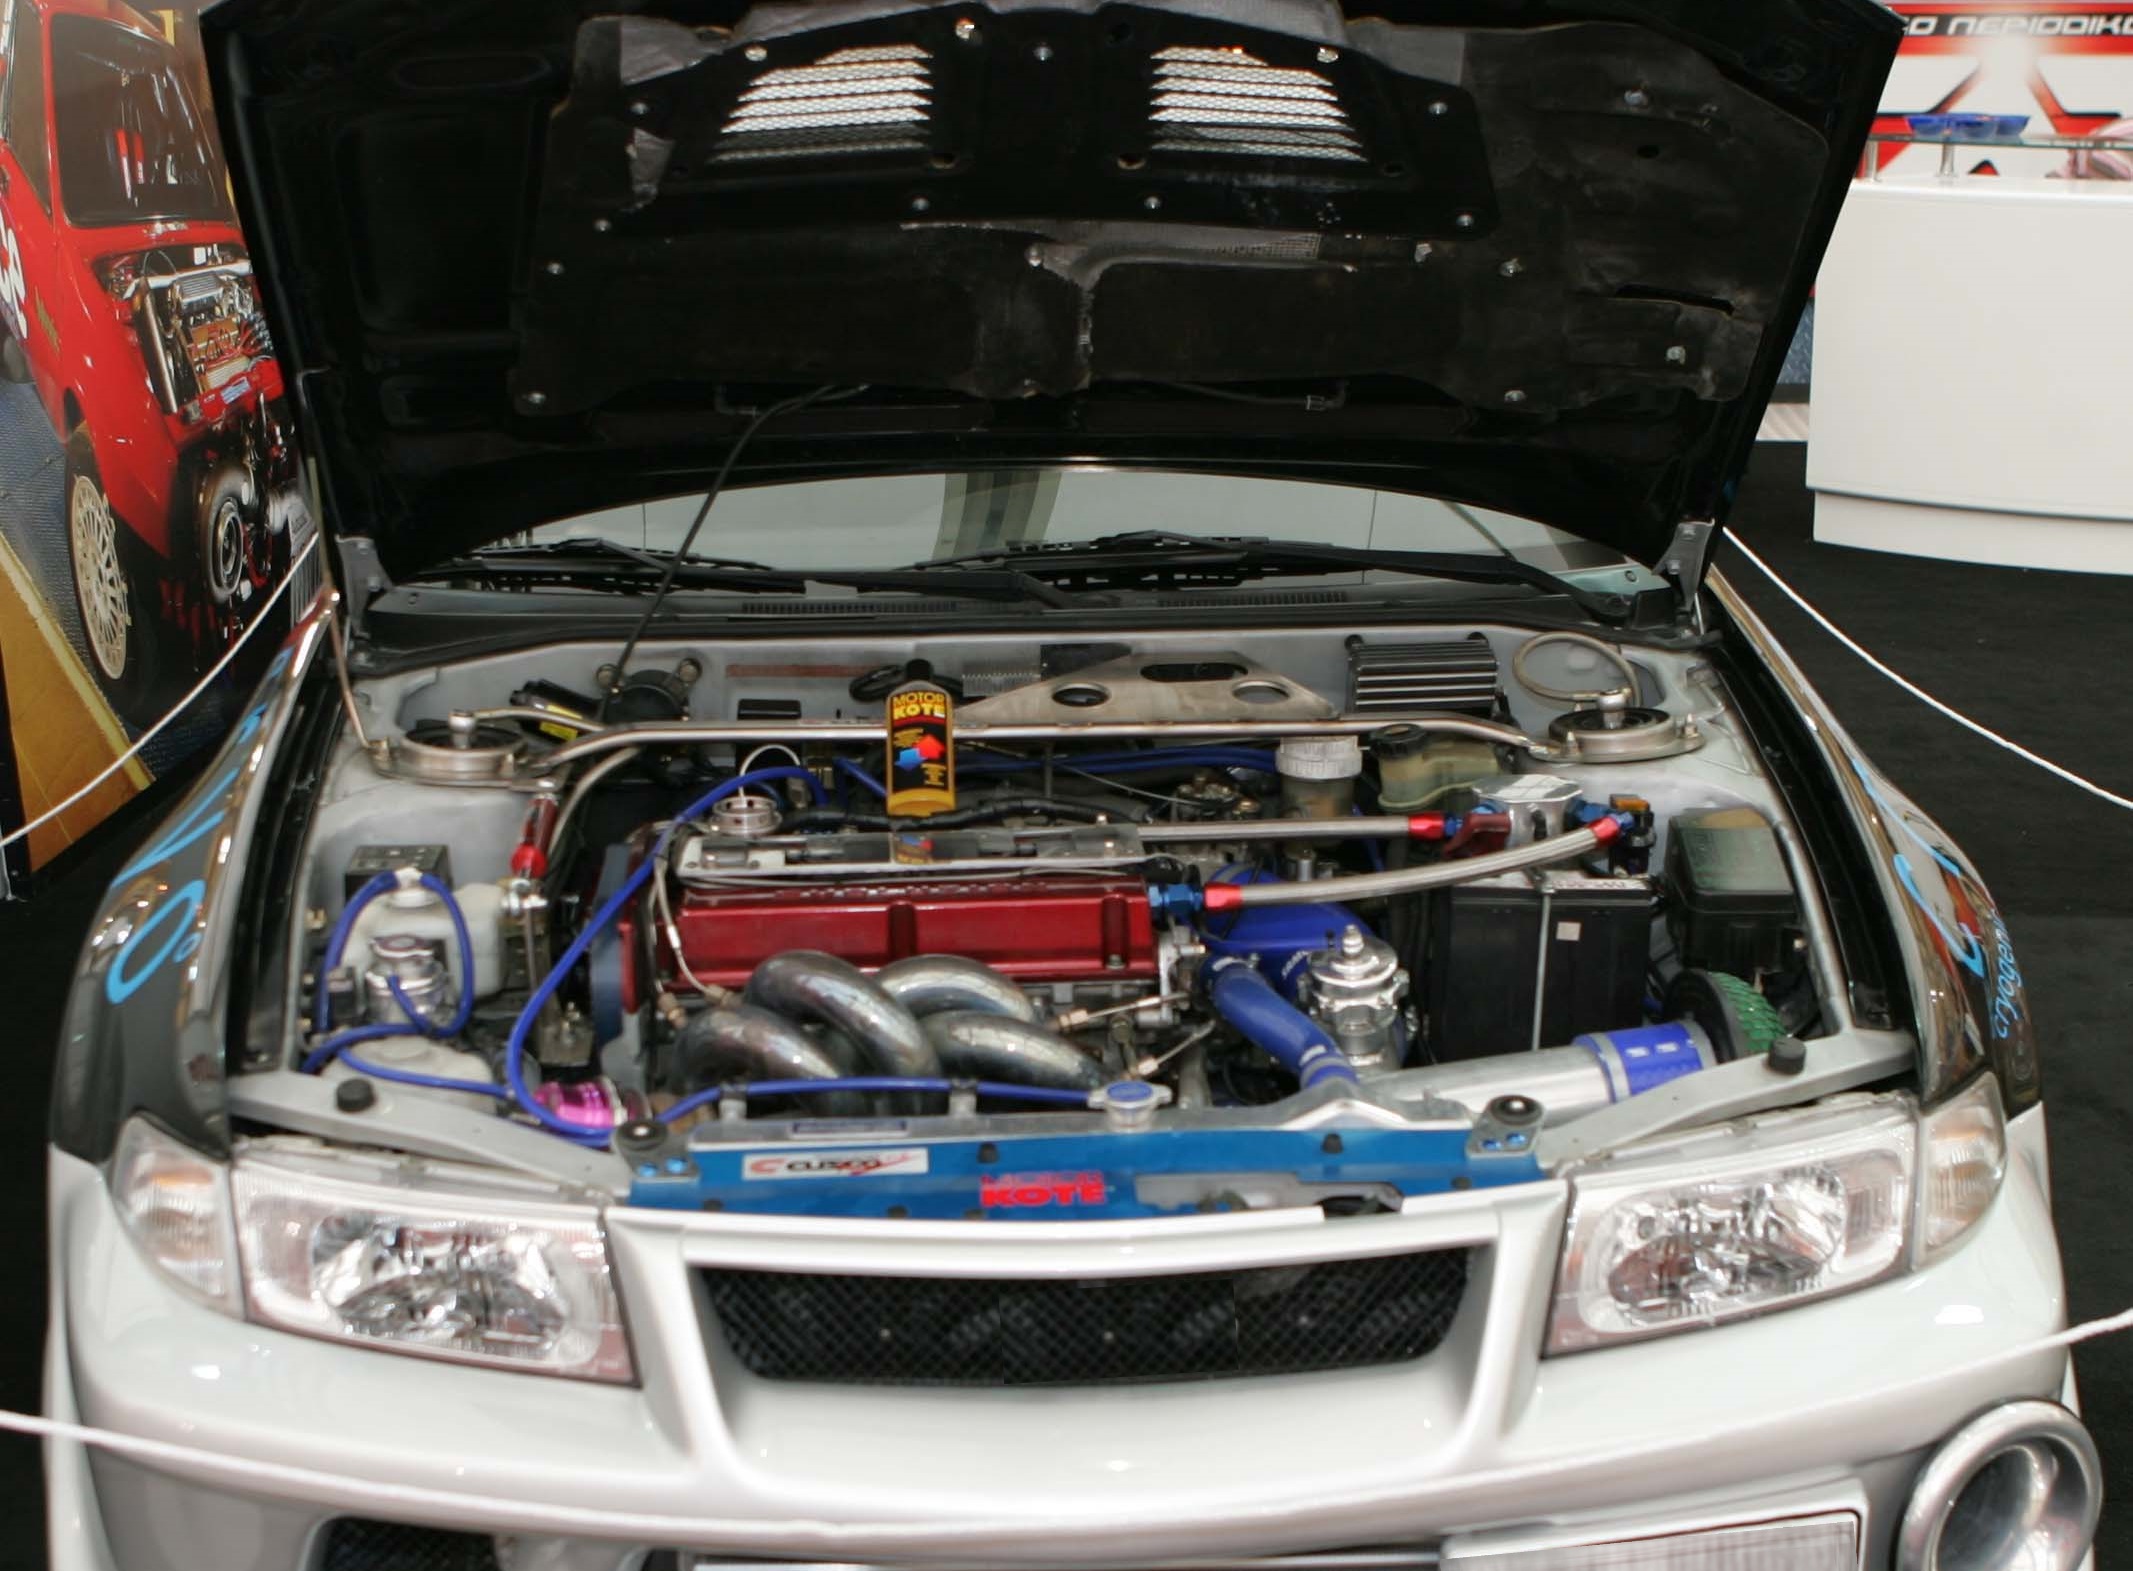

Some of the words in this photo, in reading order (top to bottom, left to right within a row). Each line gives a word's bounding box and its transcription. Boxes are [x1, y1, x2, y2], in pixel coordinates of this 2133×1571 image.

[893, 692, 945, 705] MOTOR
[894, 704, 946, 719] KOTE
[981, 1185, 1105, 1207] KOTE
